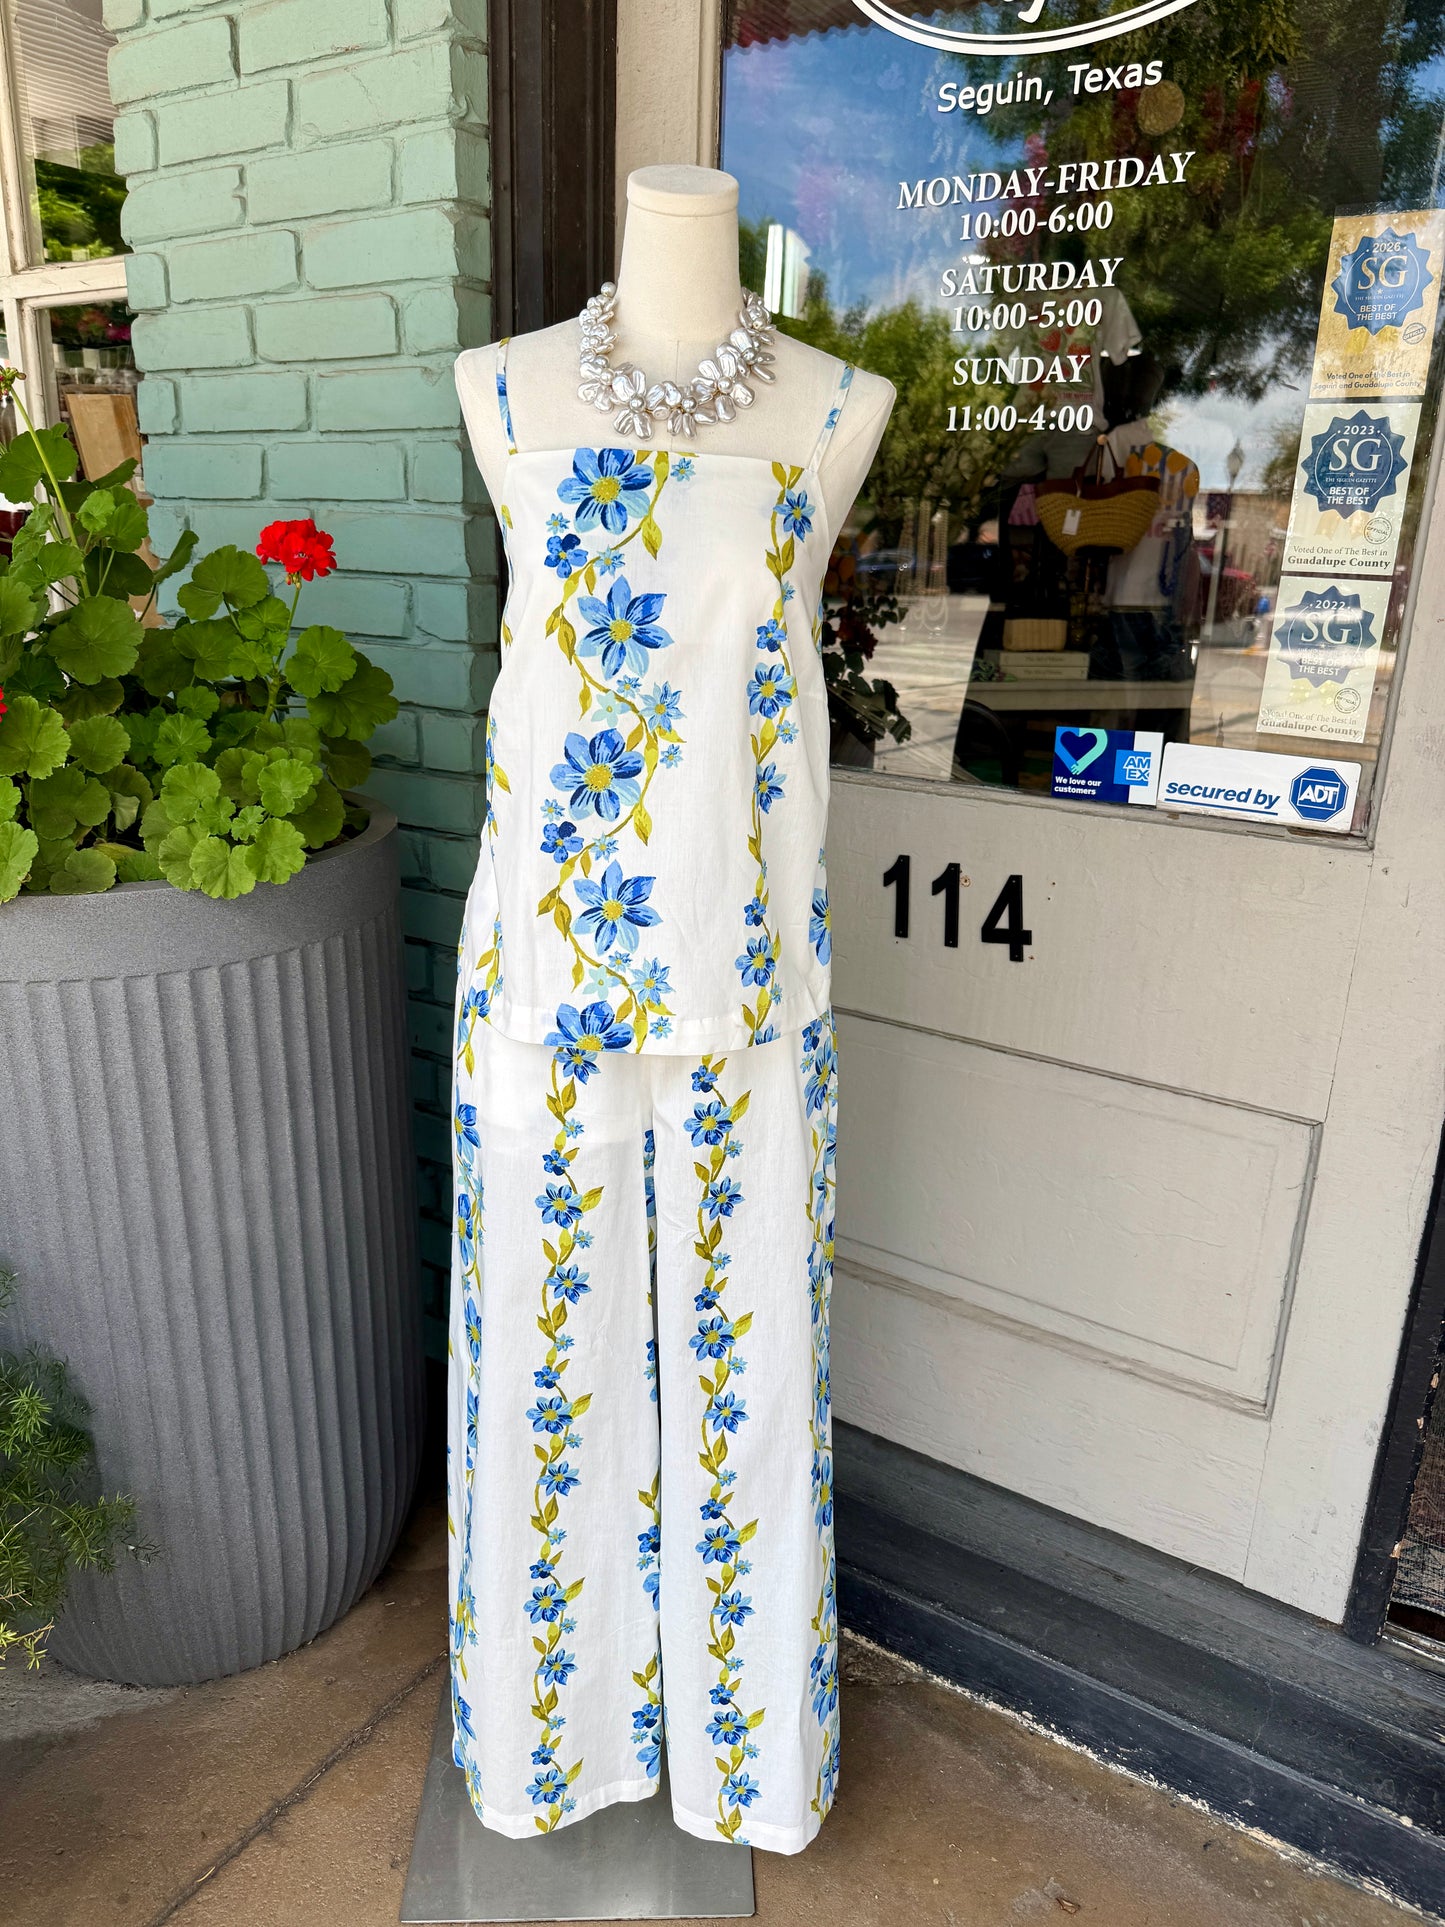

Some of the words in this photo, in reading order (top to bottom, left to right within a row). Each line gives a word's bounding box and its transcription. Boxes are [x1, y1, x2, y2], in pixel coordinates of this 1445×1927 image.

[937, 71, 1053, 115] Seguin,
[1067, 60, 1163, 95] Texas
[896, 151, 1196, 210] MONDAY-FRIDAY
[959, 201, 1113, 241] 10:00-6:00
[1372, 242, 1401, 253] 2026
[940, 257, 1124, 298] SATURDAY
[1357, 255, 1408, 290] SG
[1360, 304, 1383, 312] BEST
[952, 298, 1102, 332] 10:00-5:00
[1375, 312, 1397, 320] BEST
[952, 354, 1091, 386] SUNDAY
[1354, 381, 1393, 390] Guadalupe
[1395, 380, 1422, 388] County
[945, 404, 1093, 433] 11:00-4:00
[1343, 425, 1375, 435] 2023
[1328, 438, 1382, 472] SG
[1329, 486, 1353, 495] BEST
[1355, 487, 1369, 495] OF
[1327, 496, 1345, 504] THE
[1346, 497, 1370, 505] BEST
[1293, 545, 1314, 554] Voted
[1317, 546, 1333, 554] One
[1334, 546, 1343, 555] of
[1344, 547, 1360, 555] The
[1361, 548, 1378, 556] Best
[1380, 548, 1388, 556] in
[1288, 555, 1346, 568] Guadalupe
[1349, 557, 1391, 570] County
[1315, 600, 1345, 610] 2022
[1301, 612, 1352, 644] SG
[1302, 657, 1323, 666] BEST
[1299, 665, 1315, 674] THE
[1317, 667, 1340, 676] BEST
[1307, 712, 1316, 720] of
[1332, 715, 1348, 725] Best
[1261, 718, 1317, 732] Guadalupe
[1320, 724, 1360, 737] County
[1124, 756, 1151, 769] AM
[1127, 768, 1150, 781] EX
[1055, 776, 1067, 784] We
[1069, 776, 1086, 785] love
[1087, 779, 1102, 787] our
[1054, 786, 1096, 795] customers
[1165, 781, 1252, 804] secured
[1252, 789, 1280, 809] by
[1299, 784, 1339, 805] ADT
[876, 854, 1032, 962] 114
